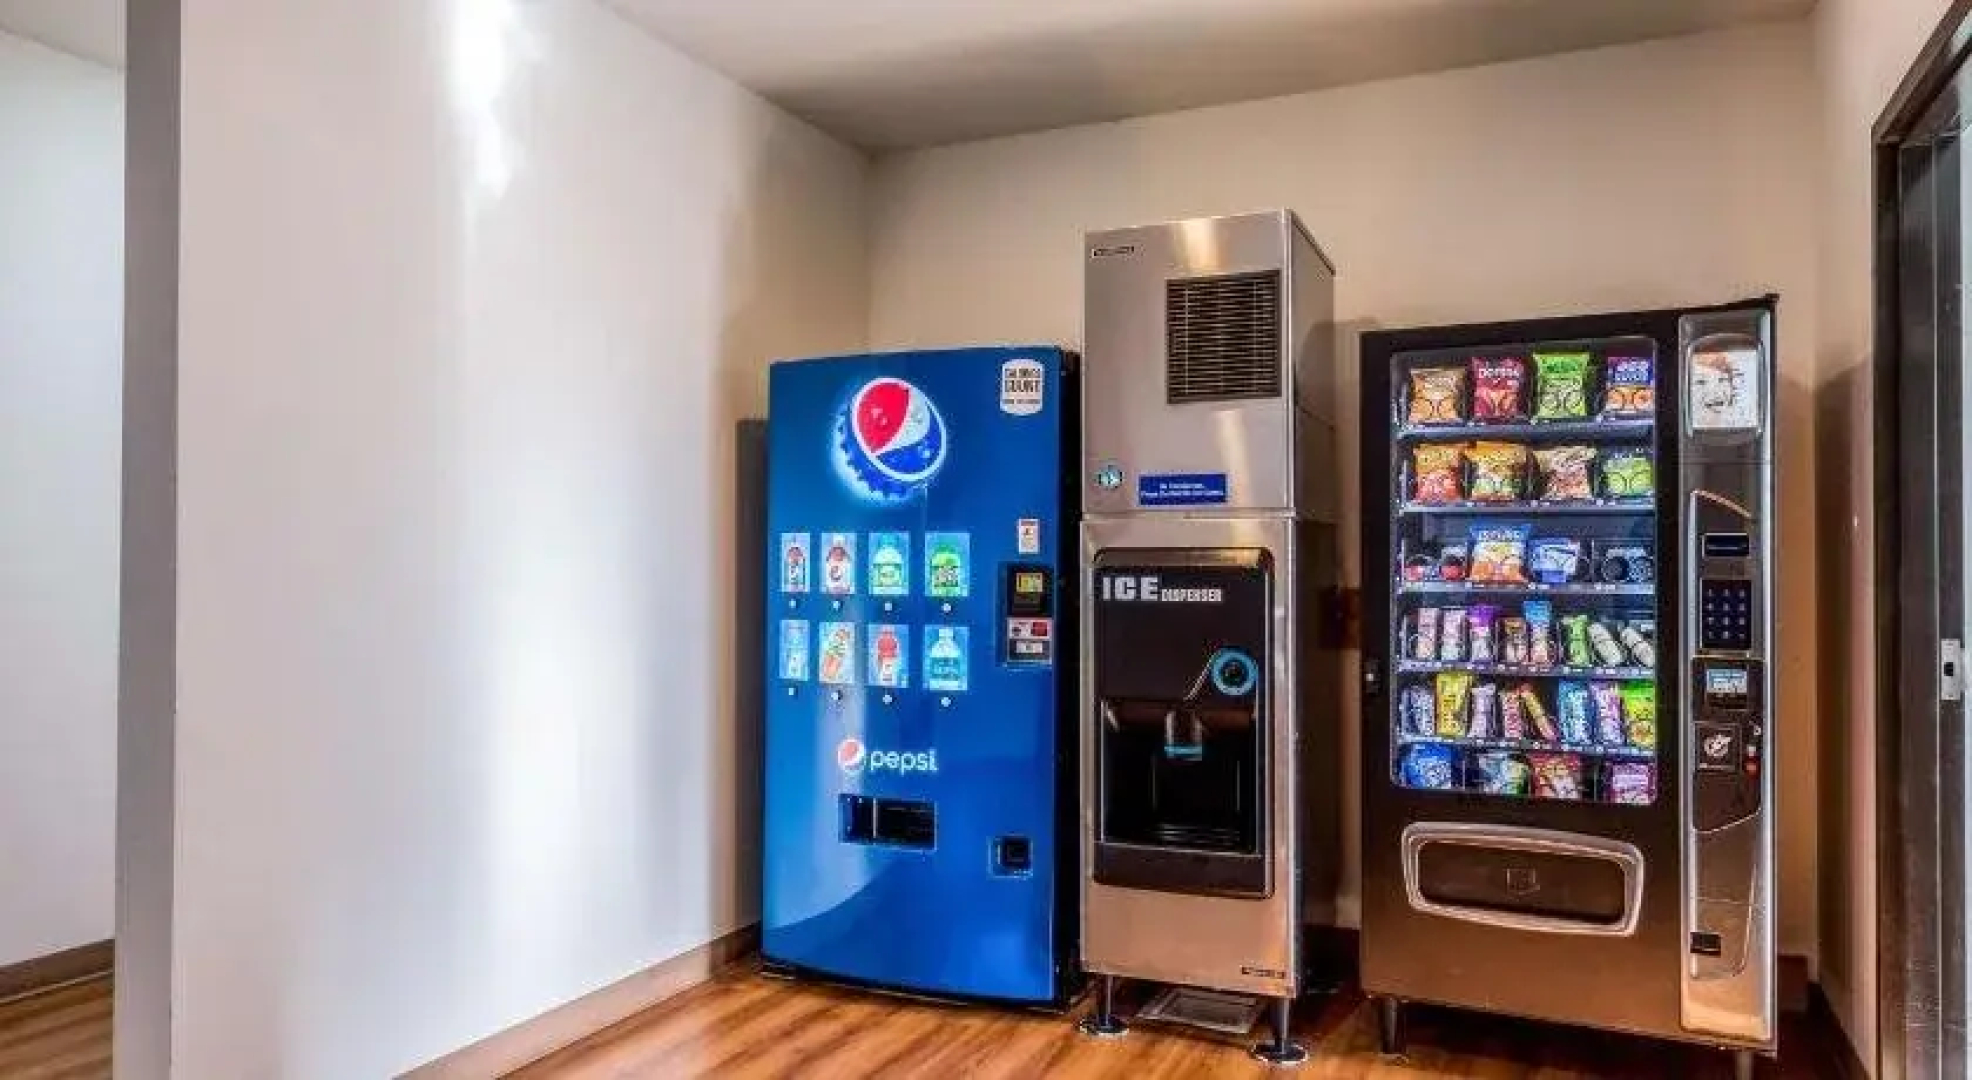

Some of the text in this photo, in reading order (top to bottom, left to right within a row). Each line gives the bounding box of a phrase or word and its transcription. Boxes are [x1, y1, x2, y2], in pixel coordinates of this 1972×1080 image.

[1102, 576, 1223, 602] ICE DISPENSER
[870, 749, 939, 777] pepsi
